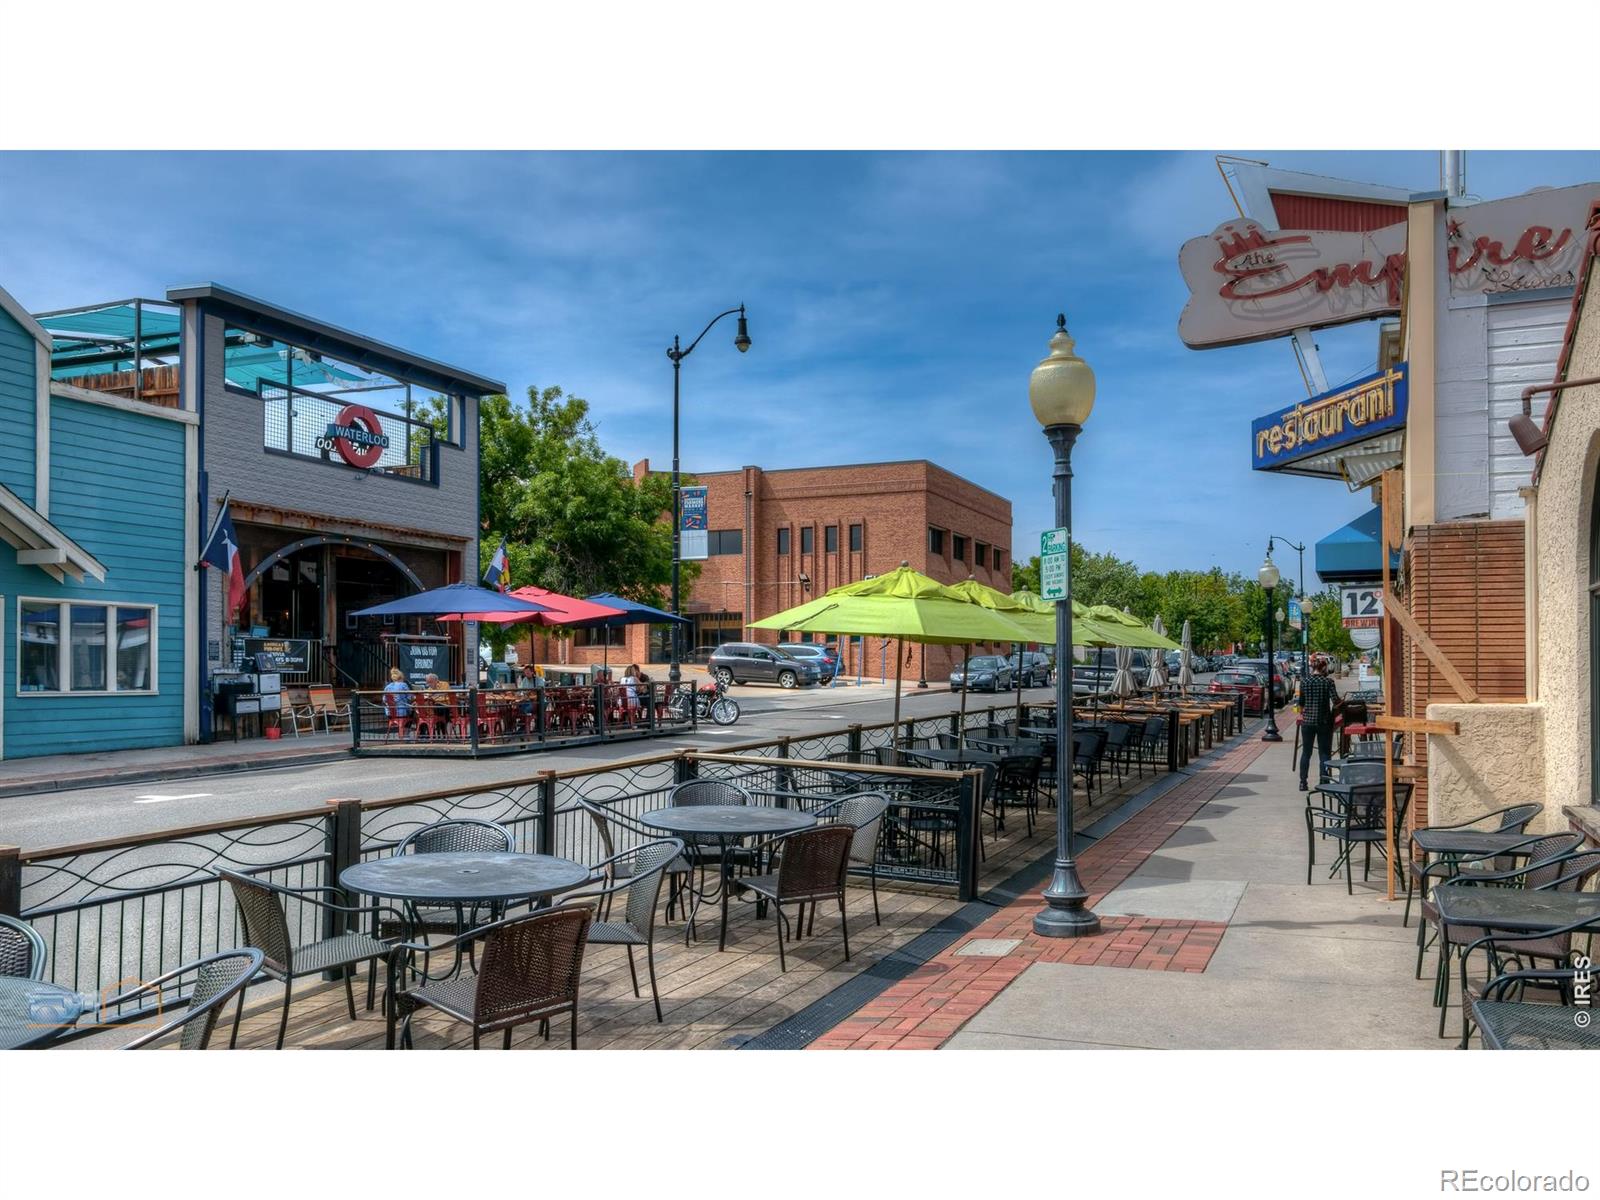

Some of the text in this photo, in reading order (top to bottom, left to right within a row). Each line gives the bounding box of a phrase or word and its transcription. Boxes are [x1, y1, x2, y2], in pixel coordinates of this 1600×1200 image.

[1256, 368, 1403, 458] restaurant
[335, 426, 388, 447] WATERLOO
[1042, 536, 1047, 553] 2
